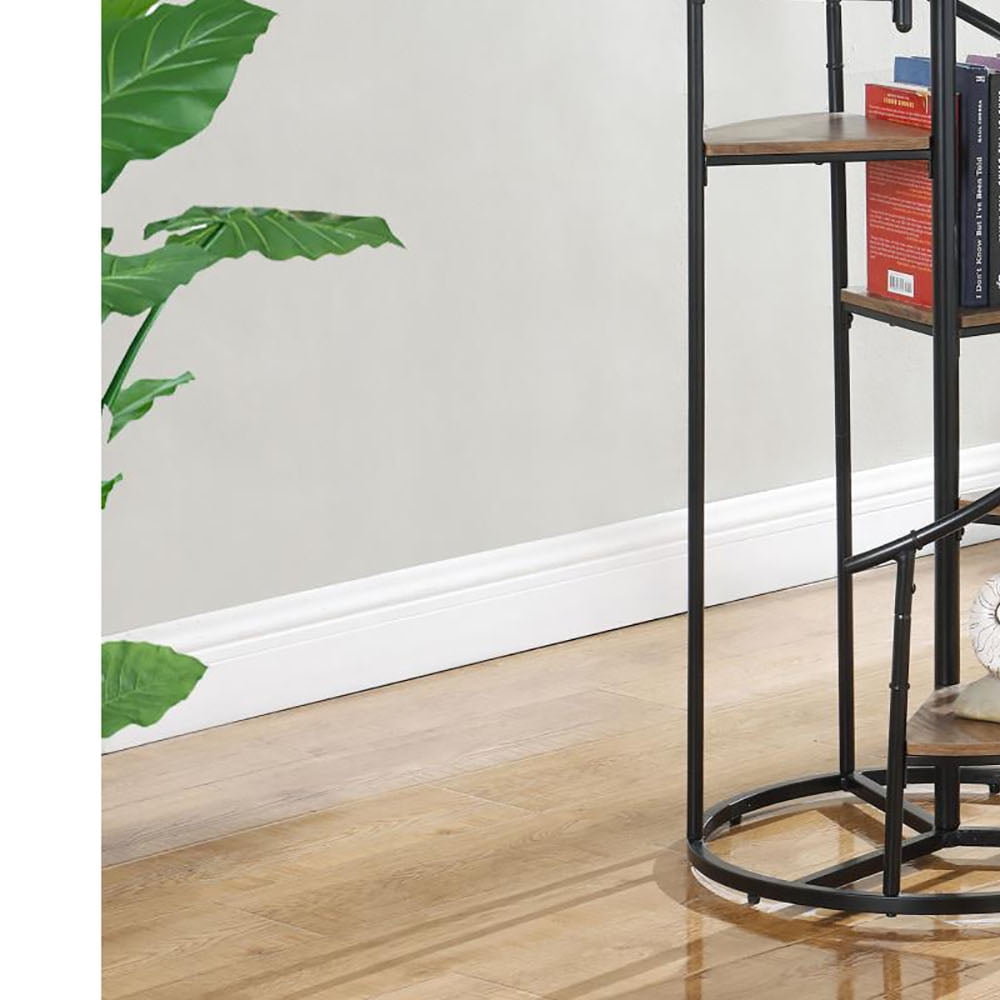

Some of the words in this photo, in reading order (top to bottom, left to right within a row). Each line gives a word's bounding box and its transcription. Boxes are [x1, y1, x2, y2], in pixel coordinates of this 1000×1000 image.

[975, 157, 983, 176] Told
[975, 179, 983, 199] Been
[975, 202, 983, 219] I've
[975, 221, 983, 236] But
[975, 240, 983, 265] Know
[975, 268, 983, 292] Don't
